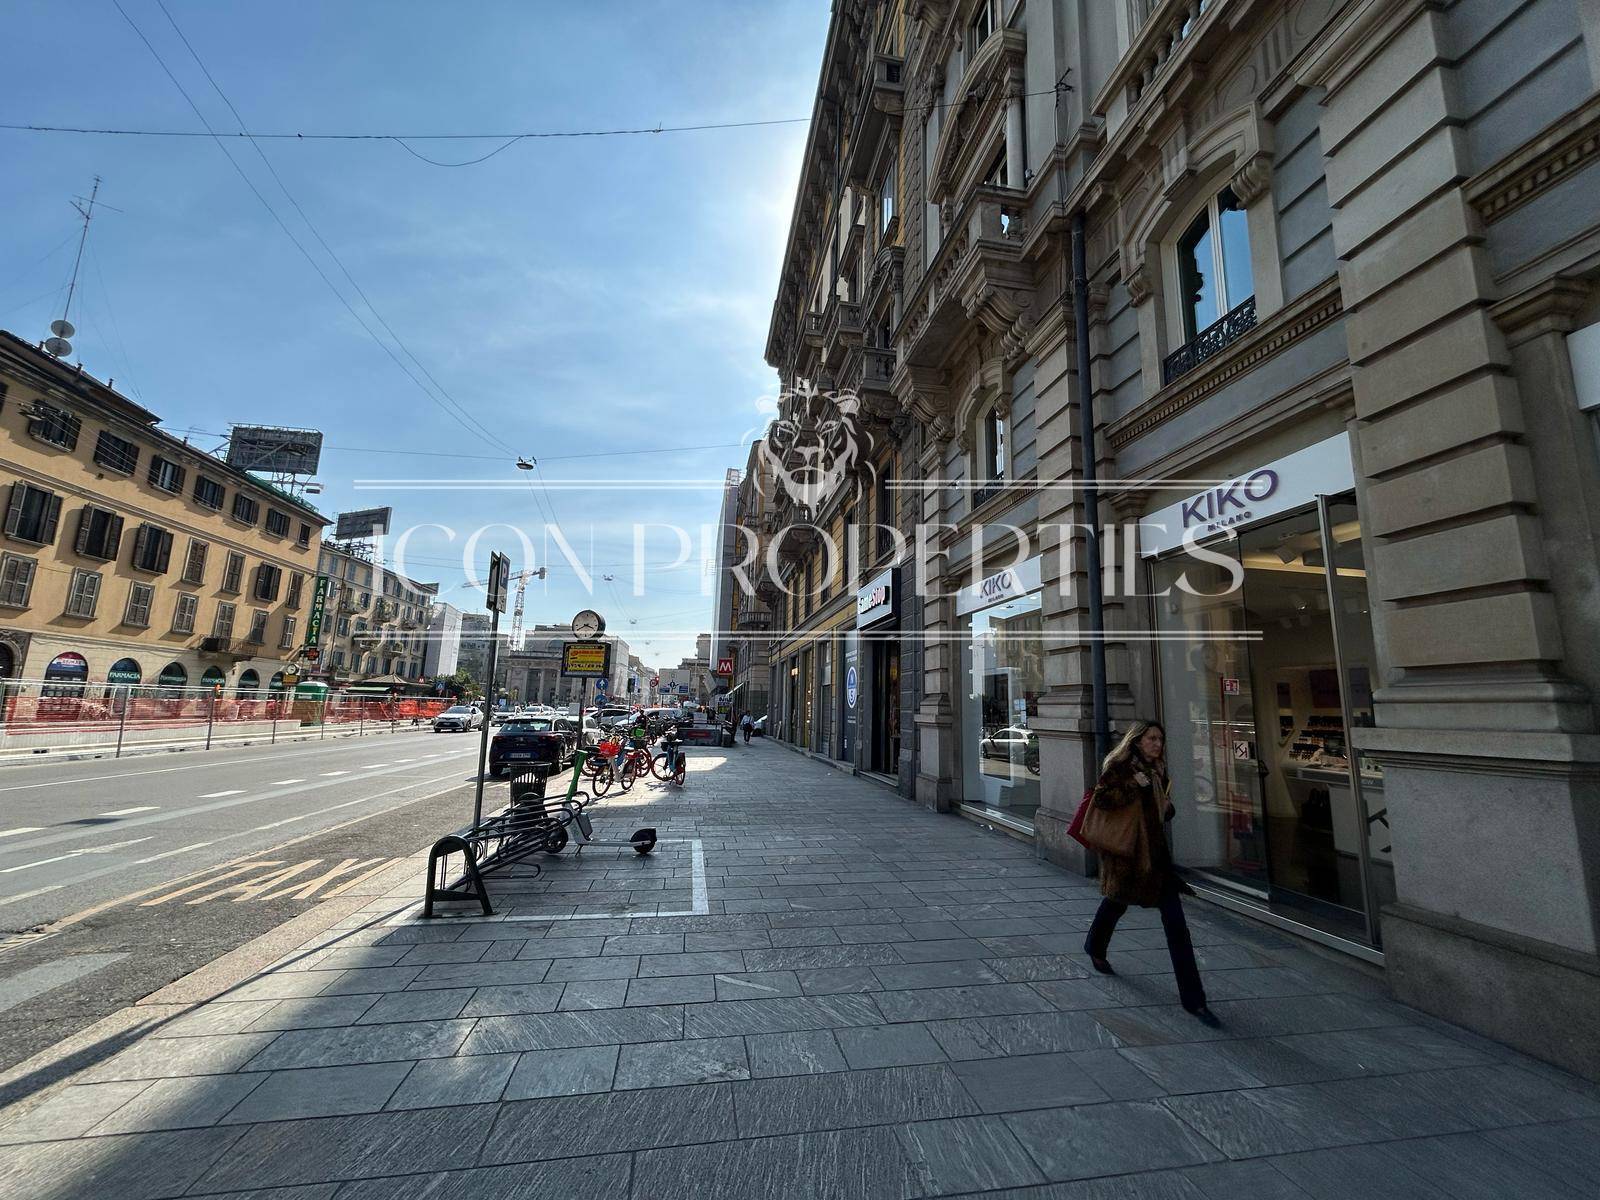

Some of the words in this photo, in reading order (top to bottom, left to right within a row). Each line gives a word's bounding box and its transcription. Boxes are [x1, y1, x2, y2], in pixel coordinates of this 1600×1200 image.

[1182, 469, 1280, 529] KIKO
[1207, 511, 1252, 533] MILANO
[980, 571, 1013, 599] KIKO
[309, 579, 326, 644] FARMACIA
[108, 671, 141, 680] FARMACIA
[136, 856, 405, 908] TAXI
